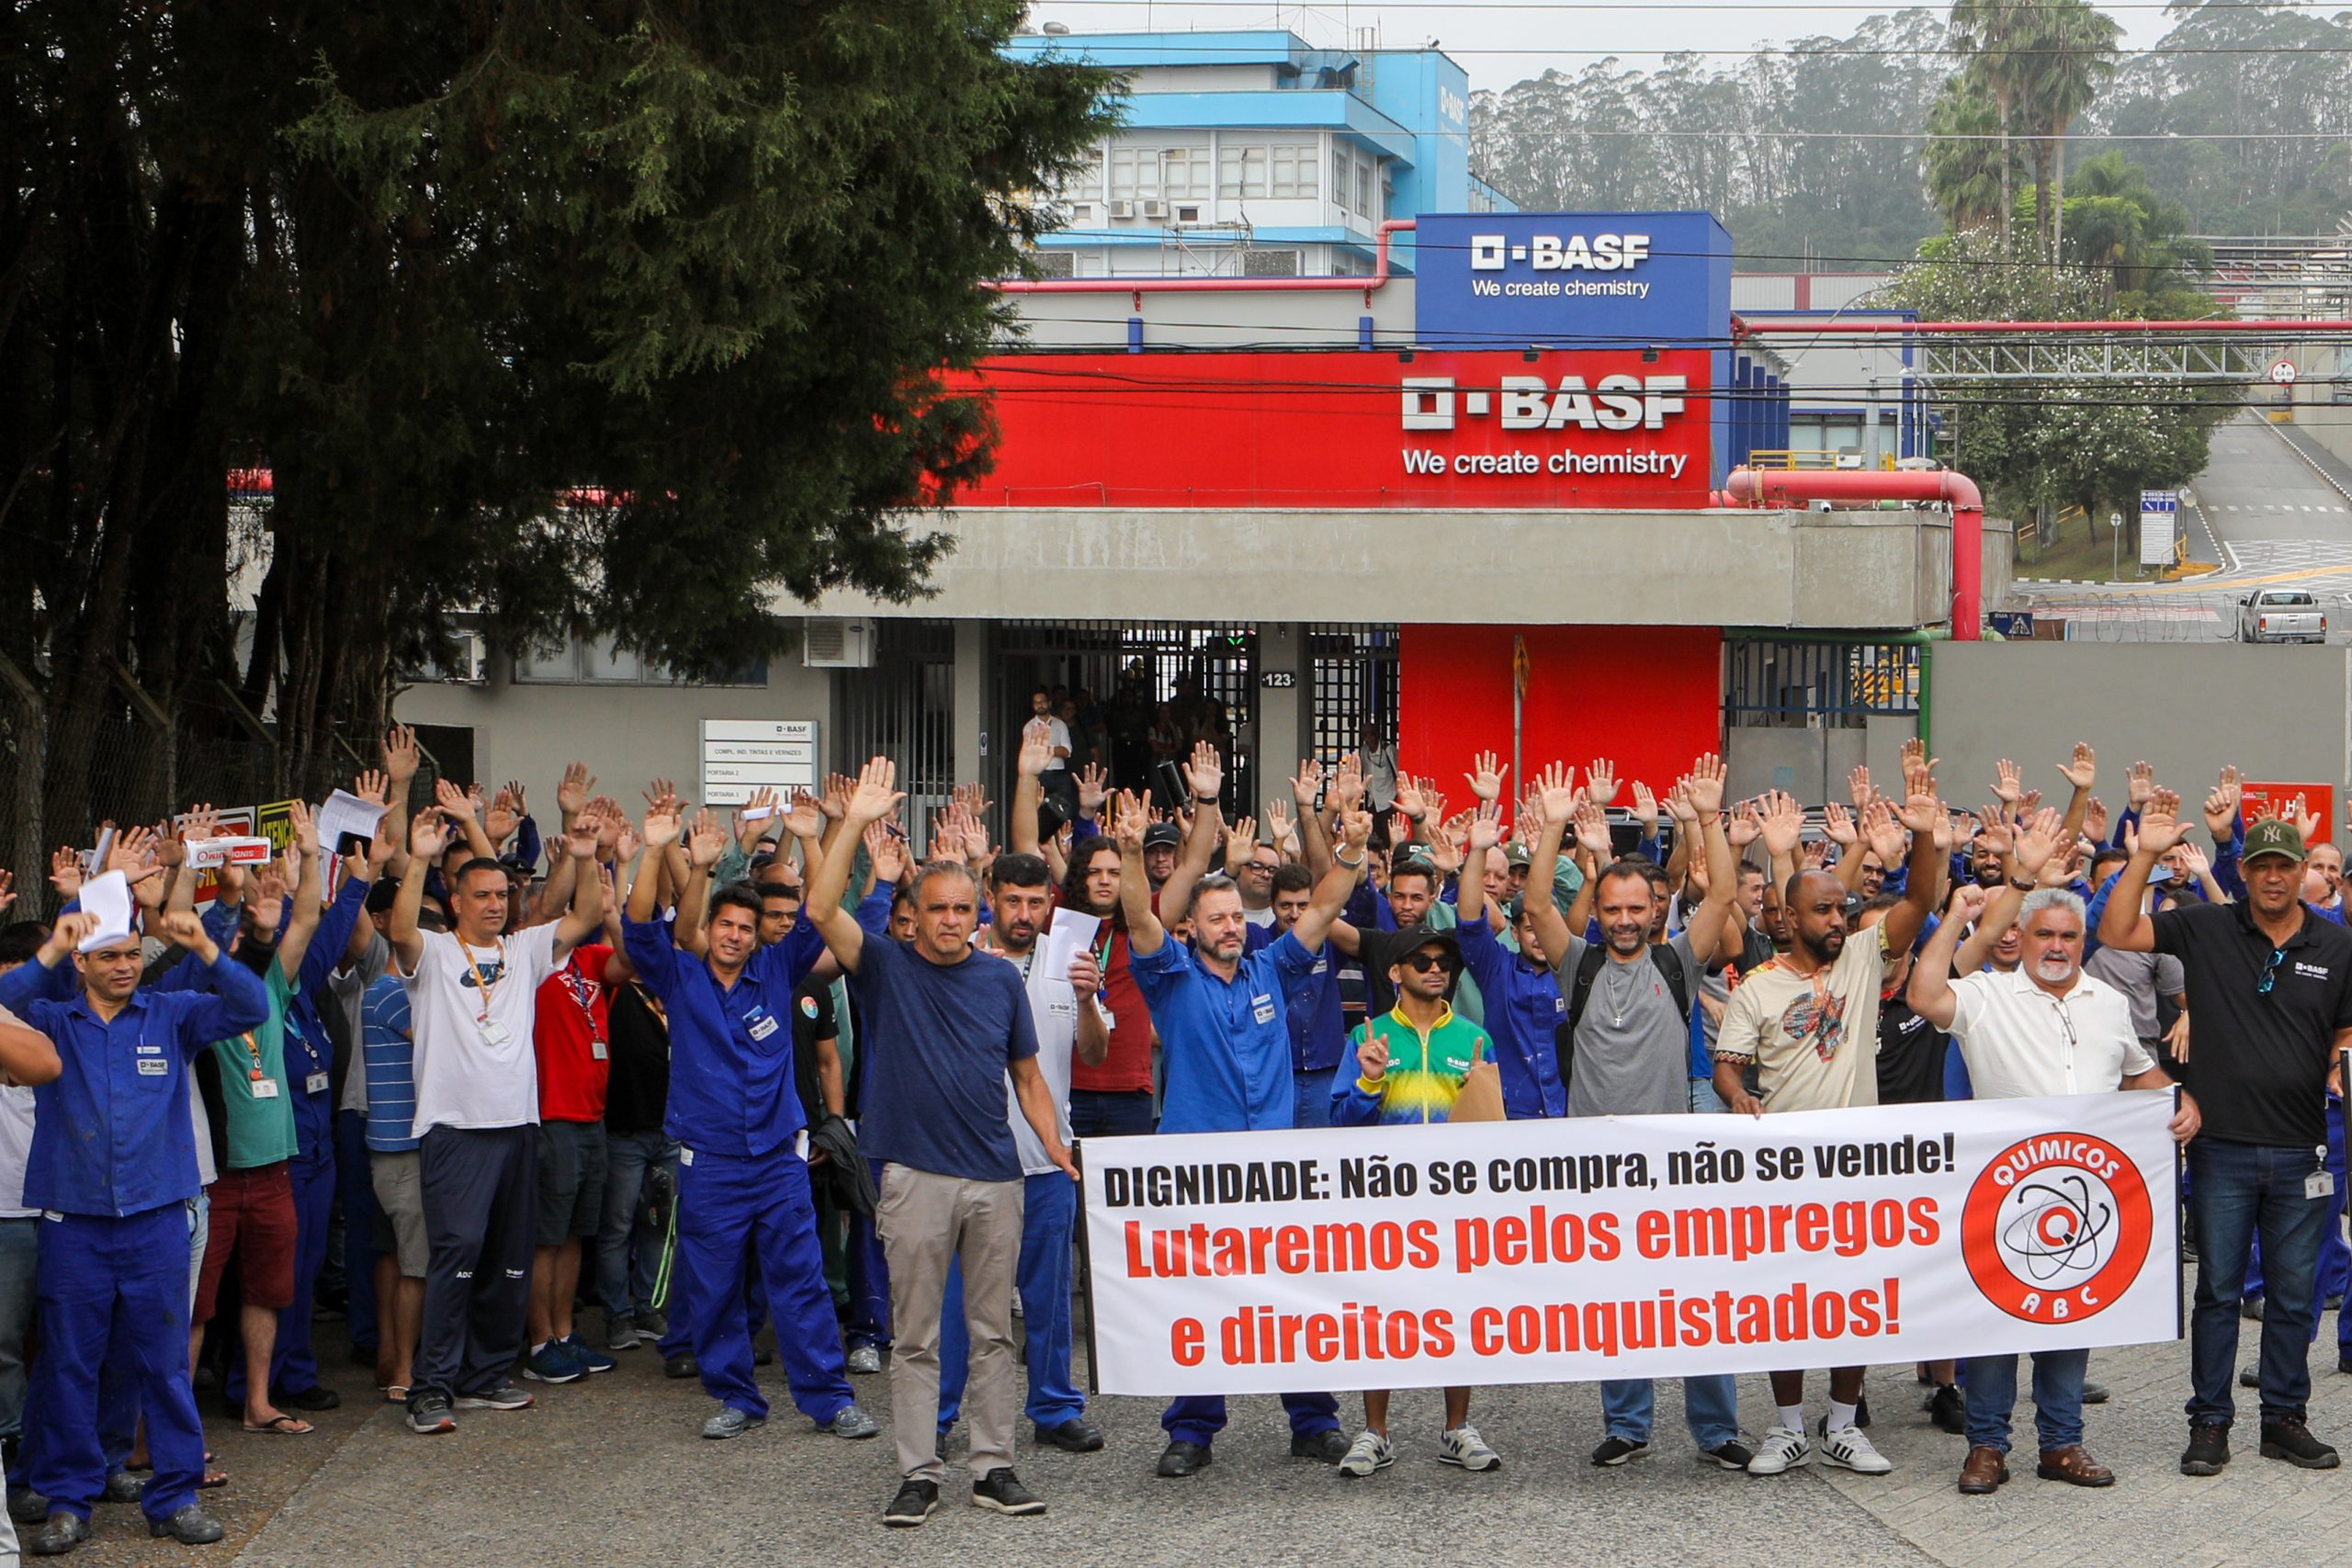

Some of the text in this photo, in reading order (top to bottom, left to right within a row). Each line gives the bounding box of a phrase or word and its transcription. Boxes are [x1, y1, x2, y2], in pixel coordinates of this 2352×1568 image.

[1532, 233, 1650, 271] BASF
[1472, 278, 1650, 299] We create chemistry
[1500, 374, 1688, 431] BASF
[1402, 448, 1688, 479] We create chemistry
[1266, 673, 1292, 686] 123
[2307, 964, 2328, 975] BASF
[1103, 1132, 1956, 1207] DIGNIDADE: Não se compra, não se vende!
[1992, 1137, 2121, 1187] QUÍMICOS
[1125, 1196, 1940, 1279] Lutaremos pelos empregos
[1170, 1276, 1900, 1367] e direitos conquistados!
